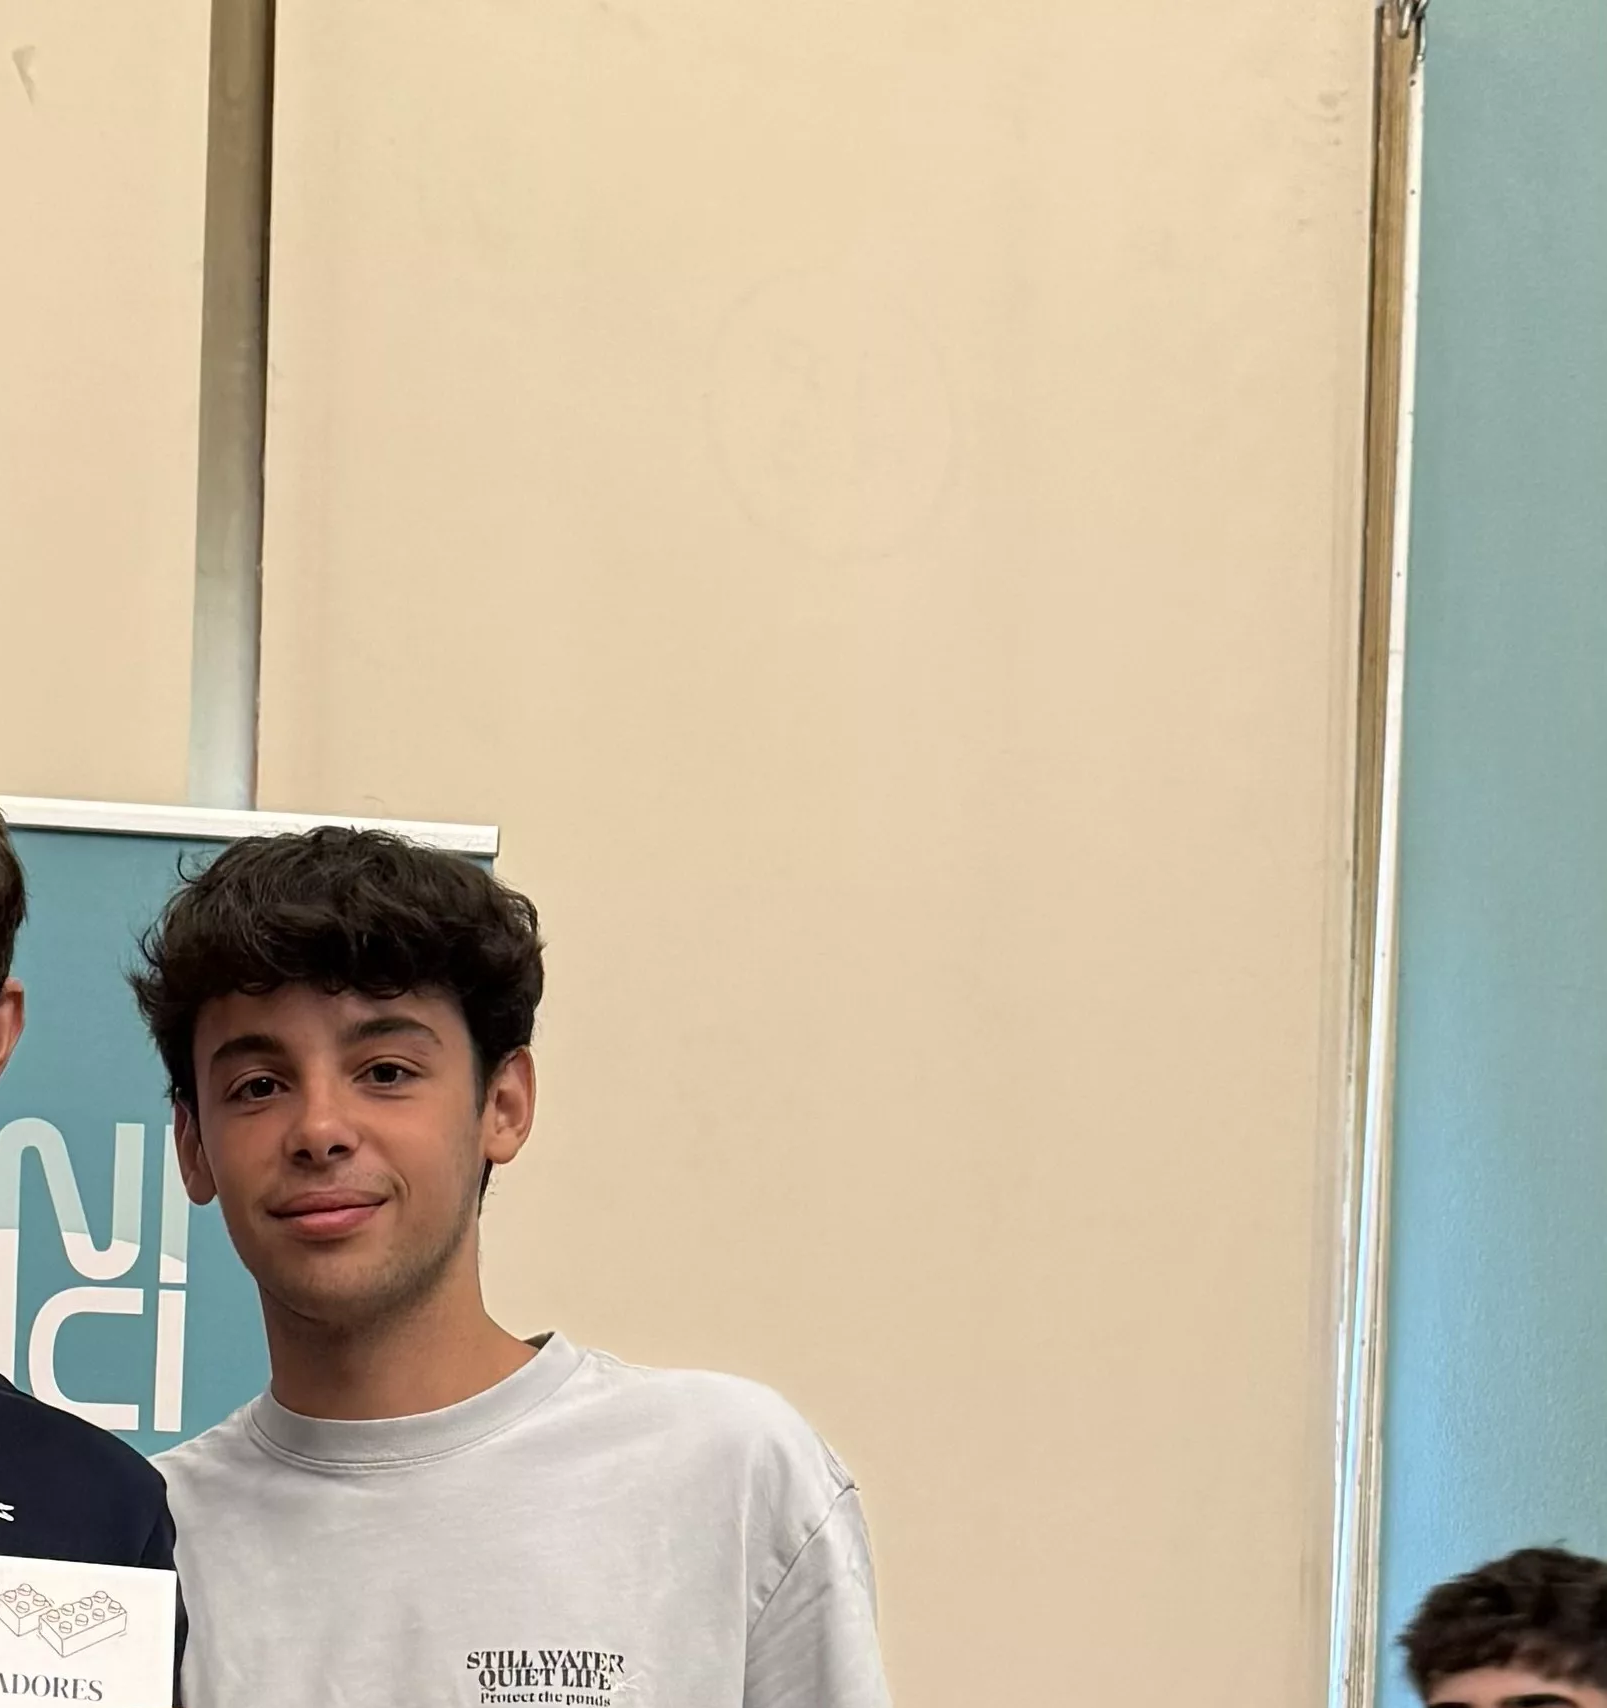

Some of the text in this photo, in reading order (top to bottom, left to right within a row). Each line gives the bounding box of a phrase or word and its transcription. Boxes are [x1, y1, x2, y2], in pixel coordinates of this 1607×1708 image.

[466, 1649, 625, 1674] STILL WATER
[478, 1668, 612, 1692] QUIET LIFE
[480, 1691, 535, 1705] Protect
[537, 1691, 563, 1704] the
